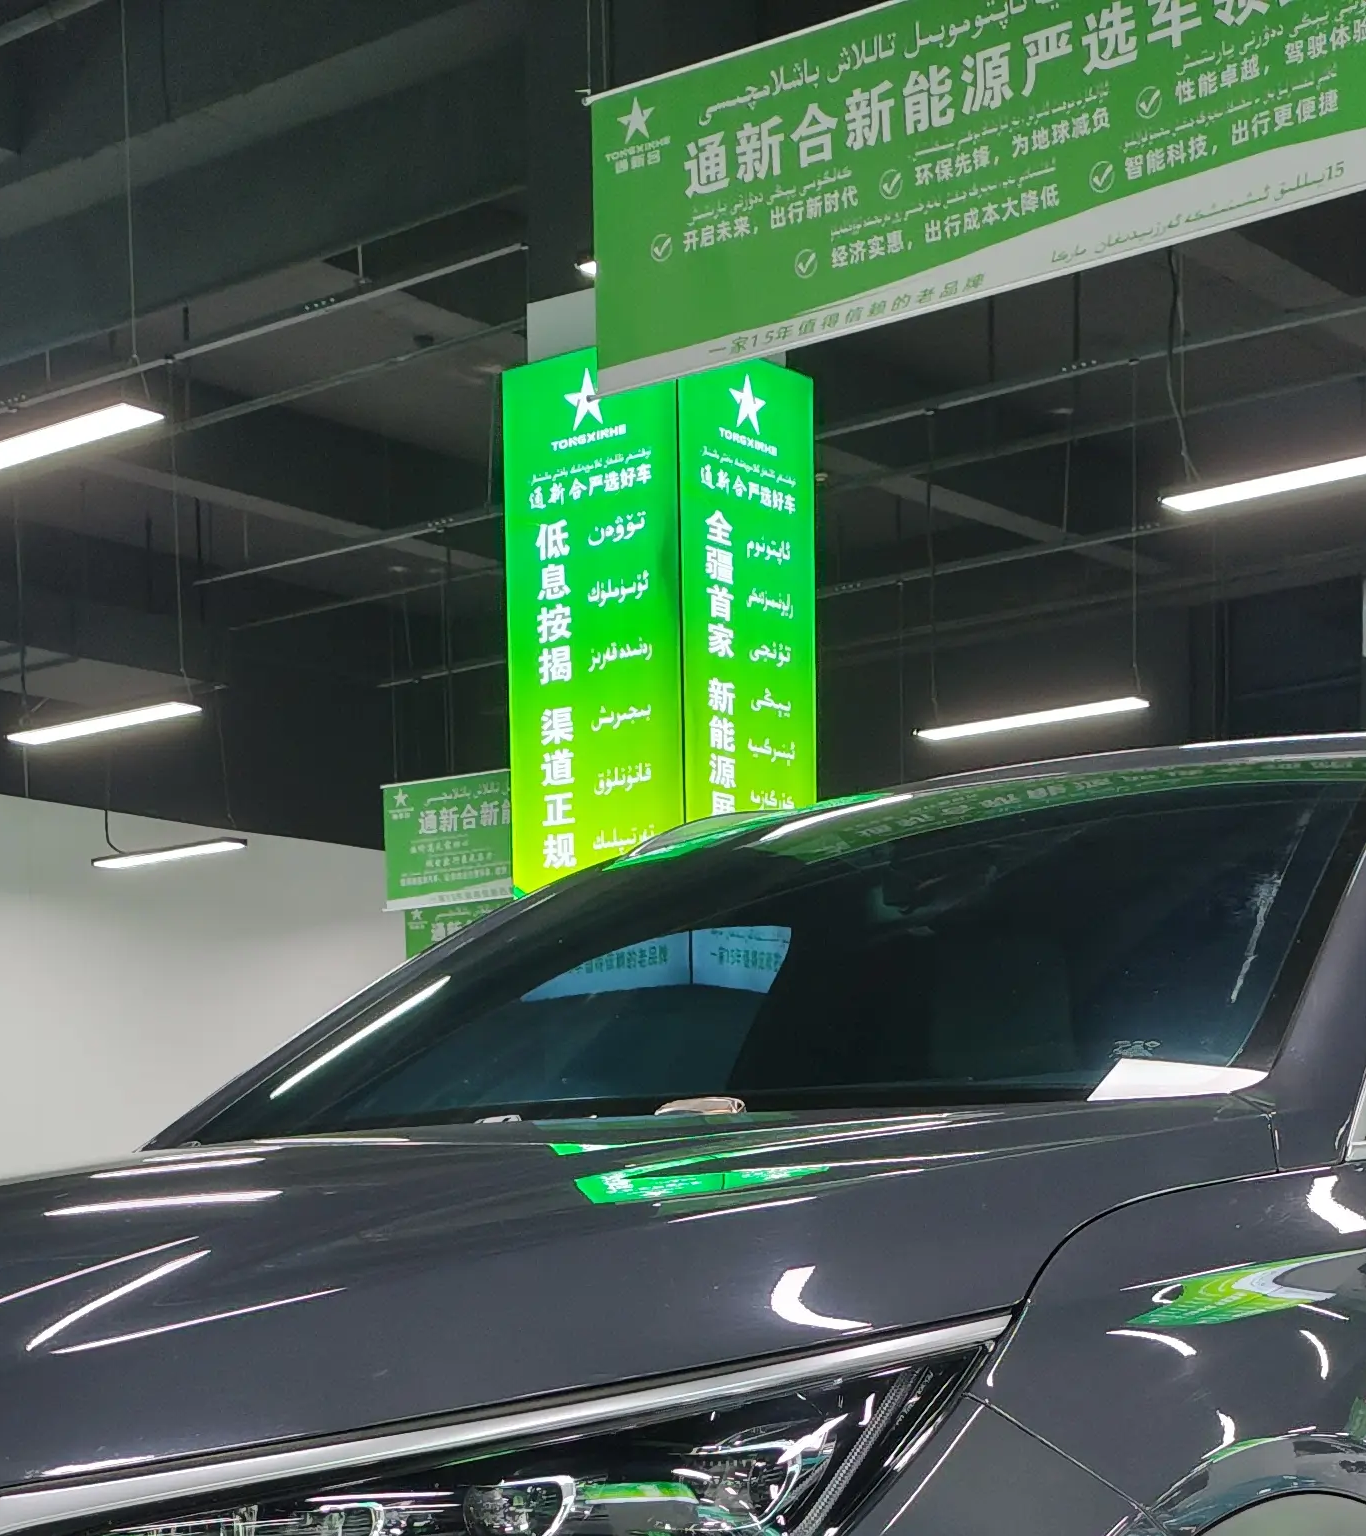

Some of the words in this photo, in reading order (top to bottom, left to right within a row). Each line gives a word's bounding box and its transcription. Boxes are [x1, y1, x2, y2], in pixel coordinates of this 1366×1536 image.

[684, 0, 1271, 198] 通新合新能源严选车
[536, 519, 573, 686] 低息按揭
[705, 510, 734, 658] 全疆首家
[541, 706, 577, 869] 渠道正规
